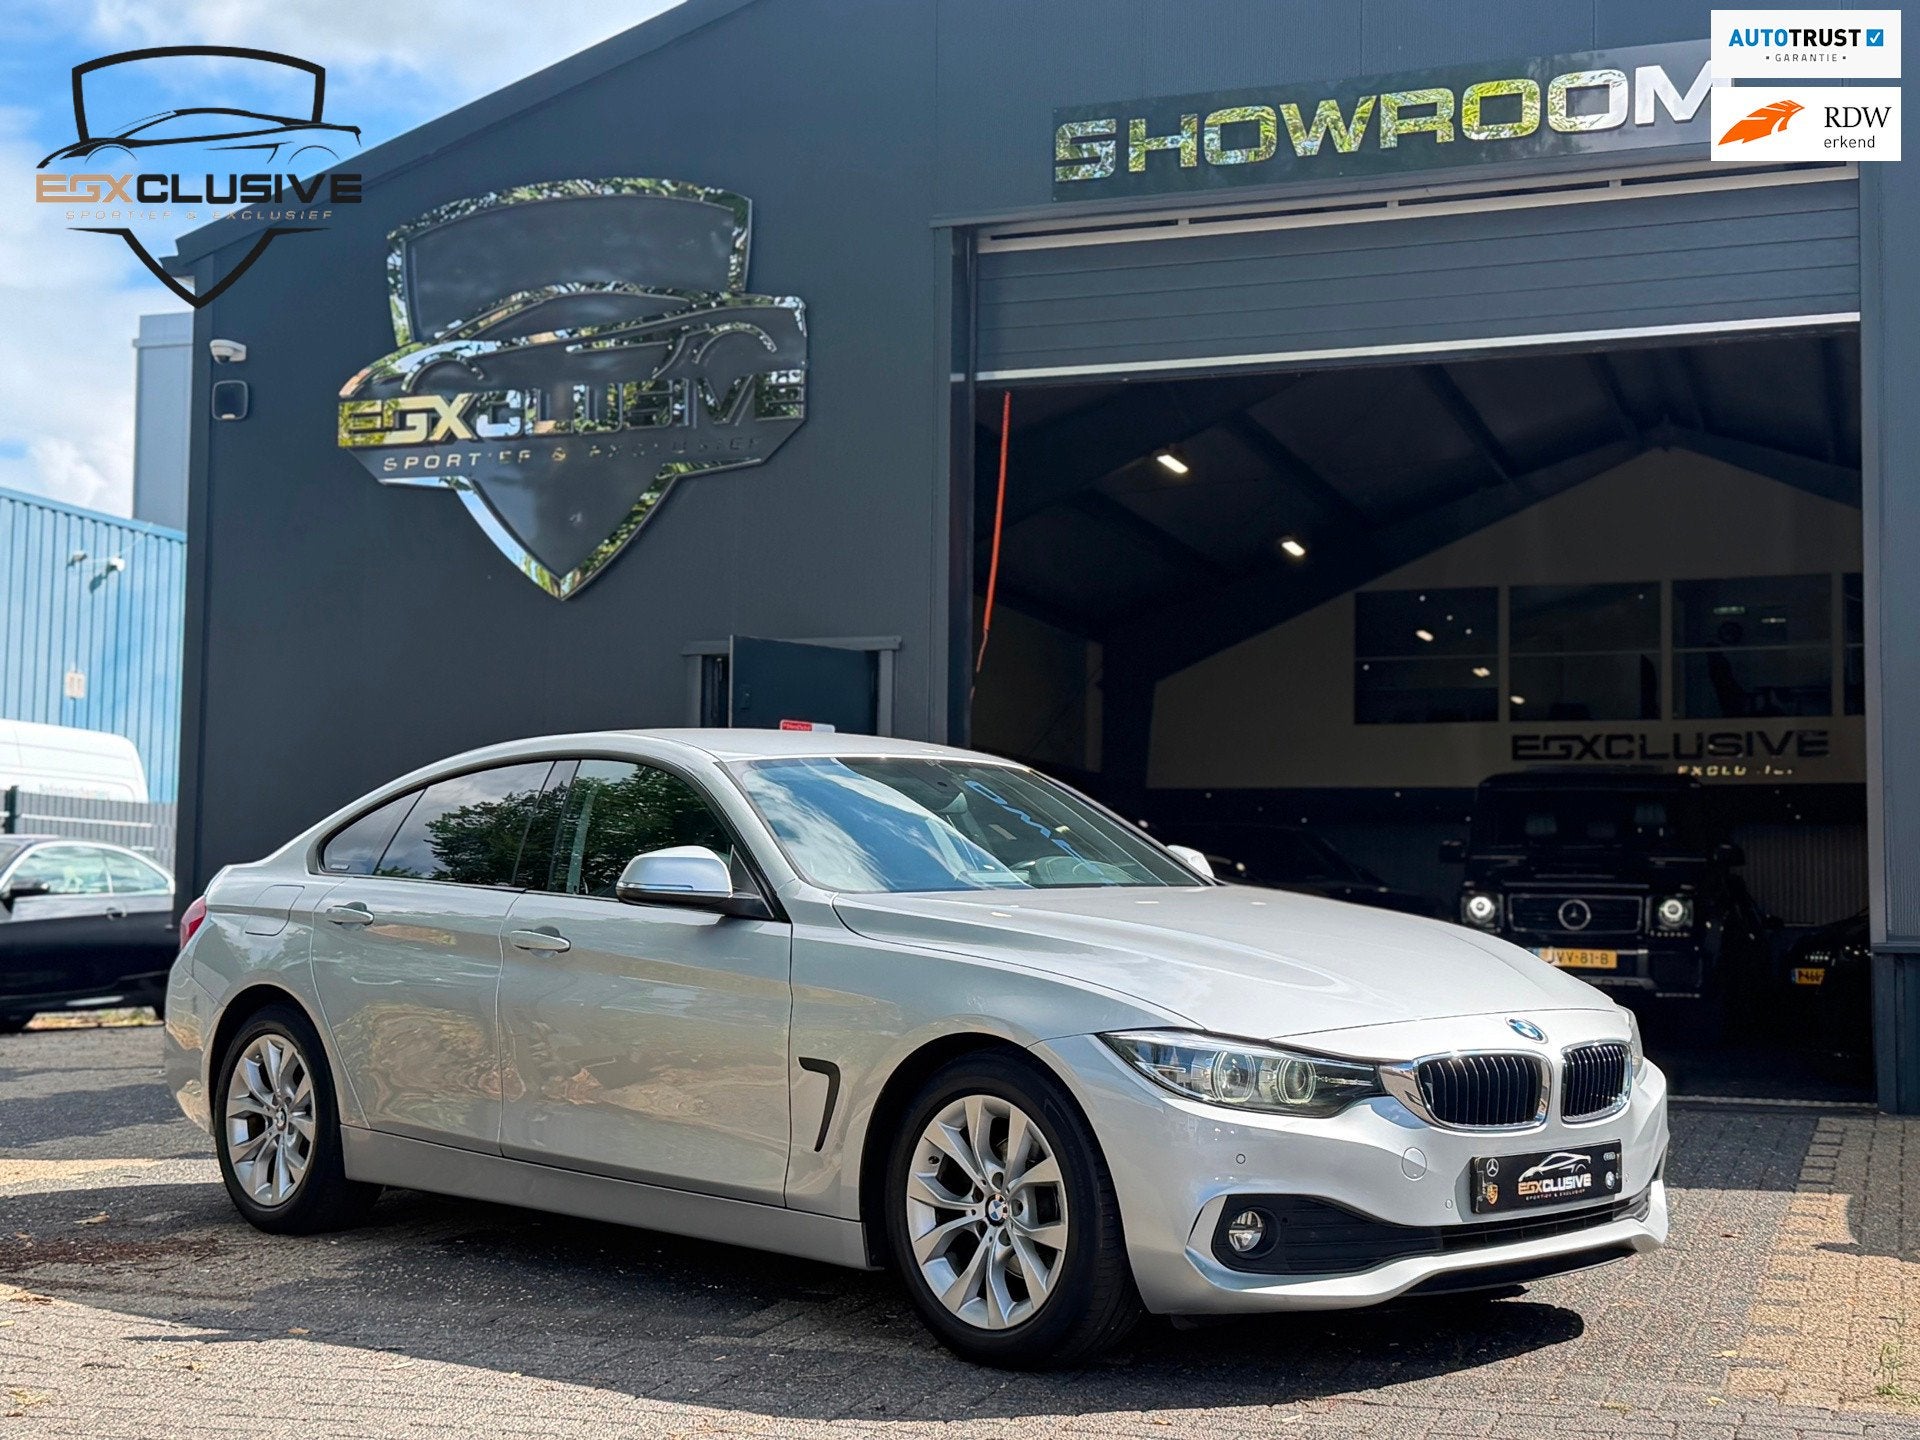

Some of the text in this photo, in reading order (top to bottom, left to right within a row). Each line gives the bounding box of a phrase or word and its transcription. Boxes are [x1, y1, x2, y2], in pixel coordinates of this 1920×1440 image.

[1055, 60, 1732, 182] SHOWROOM
[383, 449, 531, 472] SPORTEF
[1511, 729, 1829, 761] EGXCLUSIVE
[1518, 1173, 1592, 1195] EGXCLUSIVE
